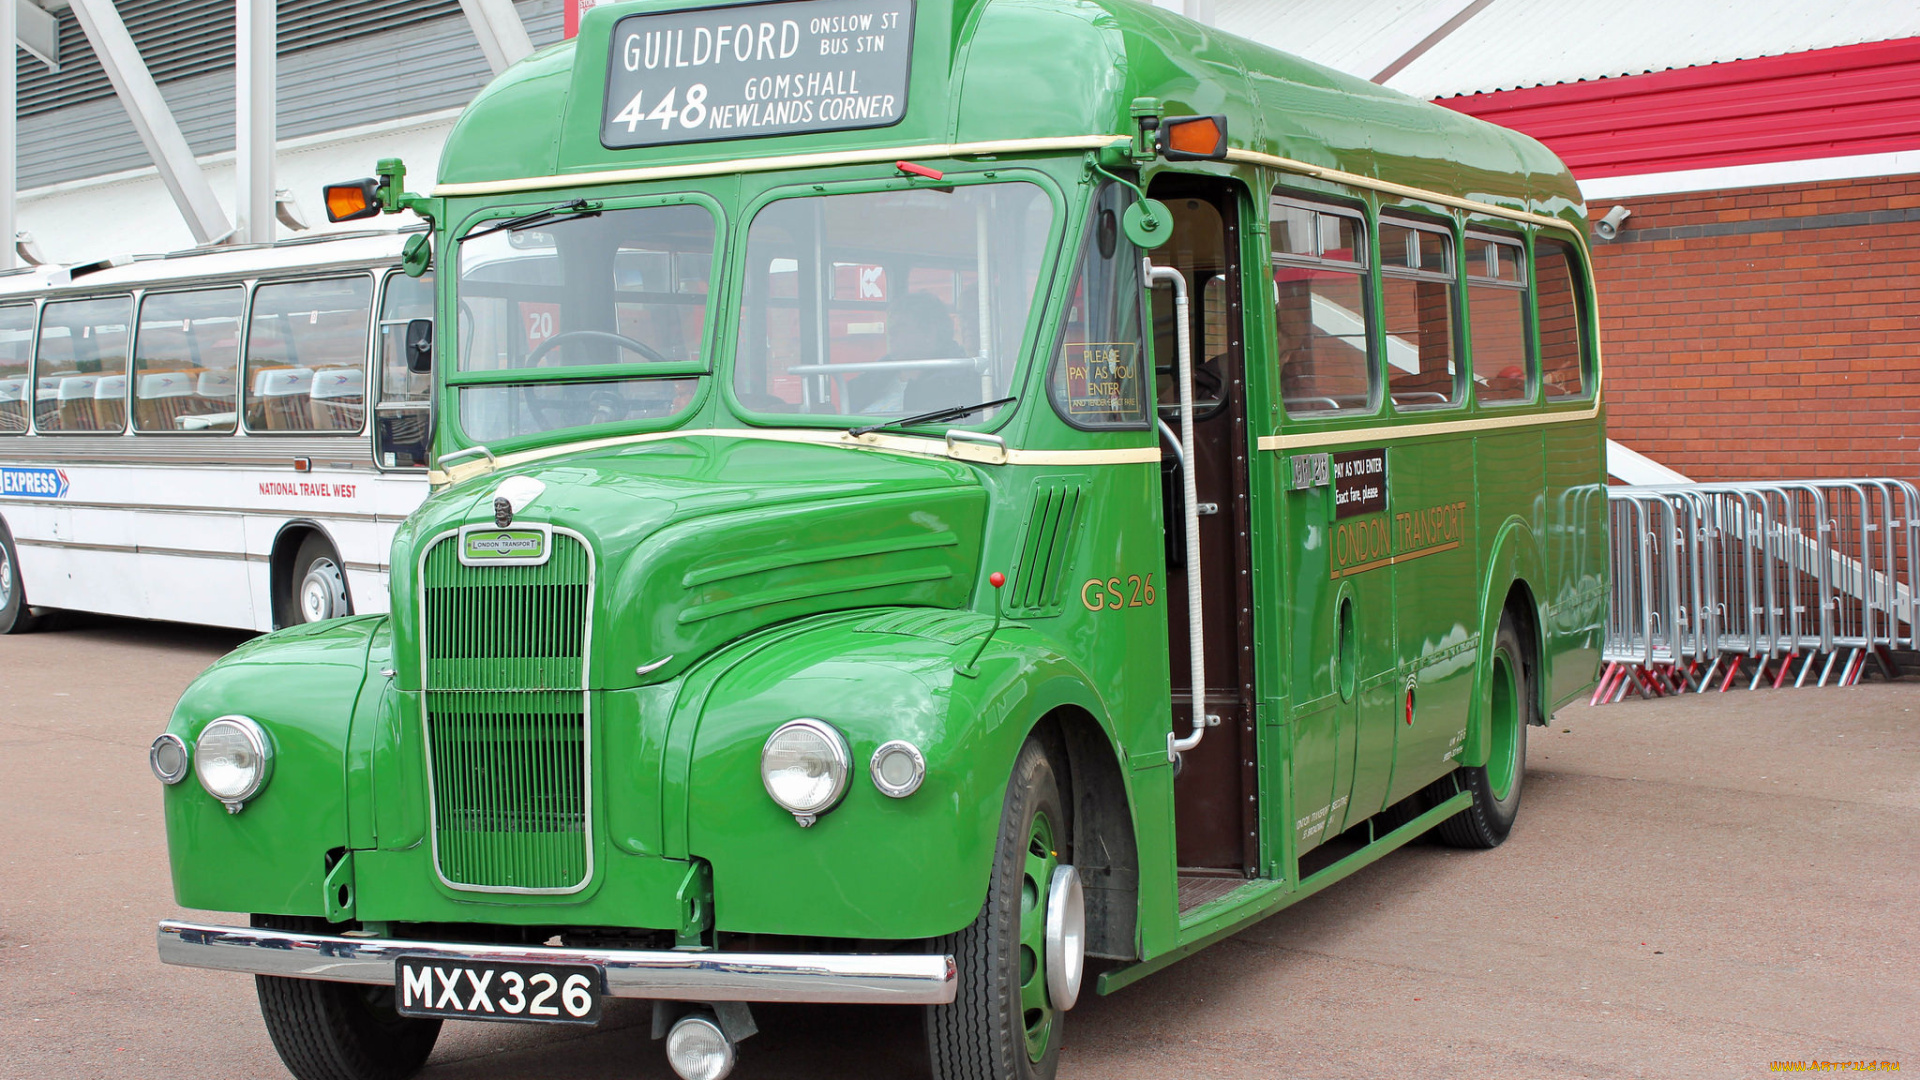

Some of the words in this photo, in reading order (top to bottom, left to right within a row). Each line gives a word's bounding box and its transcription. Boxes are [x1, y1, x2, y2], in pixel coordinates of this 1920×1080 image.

[810, 14, 872, 34] ONSLOW
[881, 12, 898, 29] ST
[623, 20, 800, 72] GUILDFORD
[820, 38, 848, 55] BUS
[856, 35, 885, 52] STN
[744, 70, 859, 101] GOMSHALL
[611, 83, 708, 132] 448
[709, 100, 813, 129] NEWLANDS
[818, 95, 894, 120] CORNER
[529, 312, 553, 339] 20
[1069, 367, 1090, 380] PAY
[1094, 366, 1108, 379] AS
[1113, 366, 1134, 379] YOU
[1088, 382, 1120, 396] ENTER
[1334, 462, 1344, 479] PAY
[1345, 461, 1353, 477] AS
[1353, 459, 1365, 475] YOU
[1365, 457, 1383, 474] ENTER
[3, 471, 57, 494] EXPRESS
[259, 482, 298, 496] NATIONAL
[299, 483, 331, 497] TRAVEL
[333, 484, 356, 498] WEST
[1335, 489, 1349, 505] Exact
[1362, 484, 1379, 504] please
[472, 541, 499, 549] LONDON
[502, 540, 535, 548] TRANSPORT
[1328, 515, 1390, 580] LONDON
[1396, 501, 1466, 552] TRANSPORT
[1081, 573, 1156, 612] GS26
[402, 965, 592, 1018] MXX326
